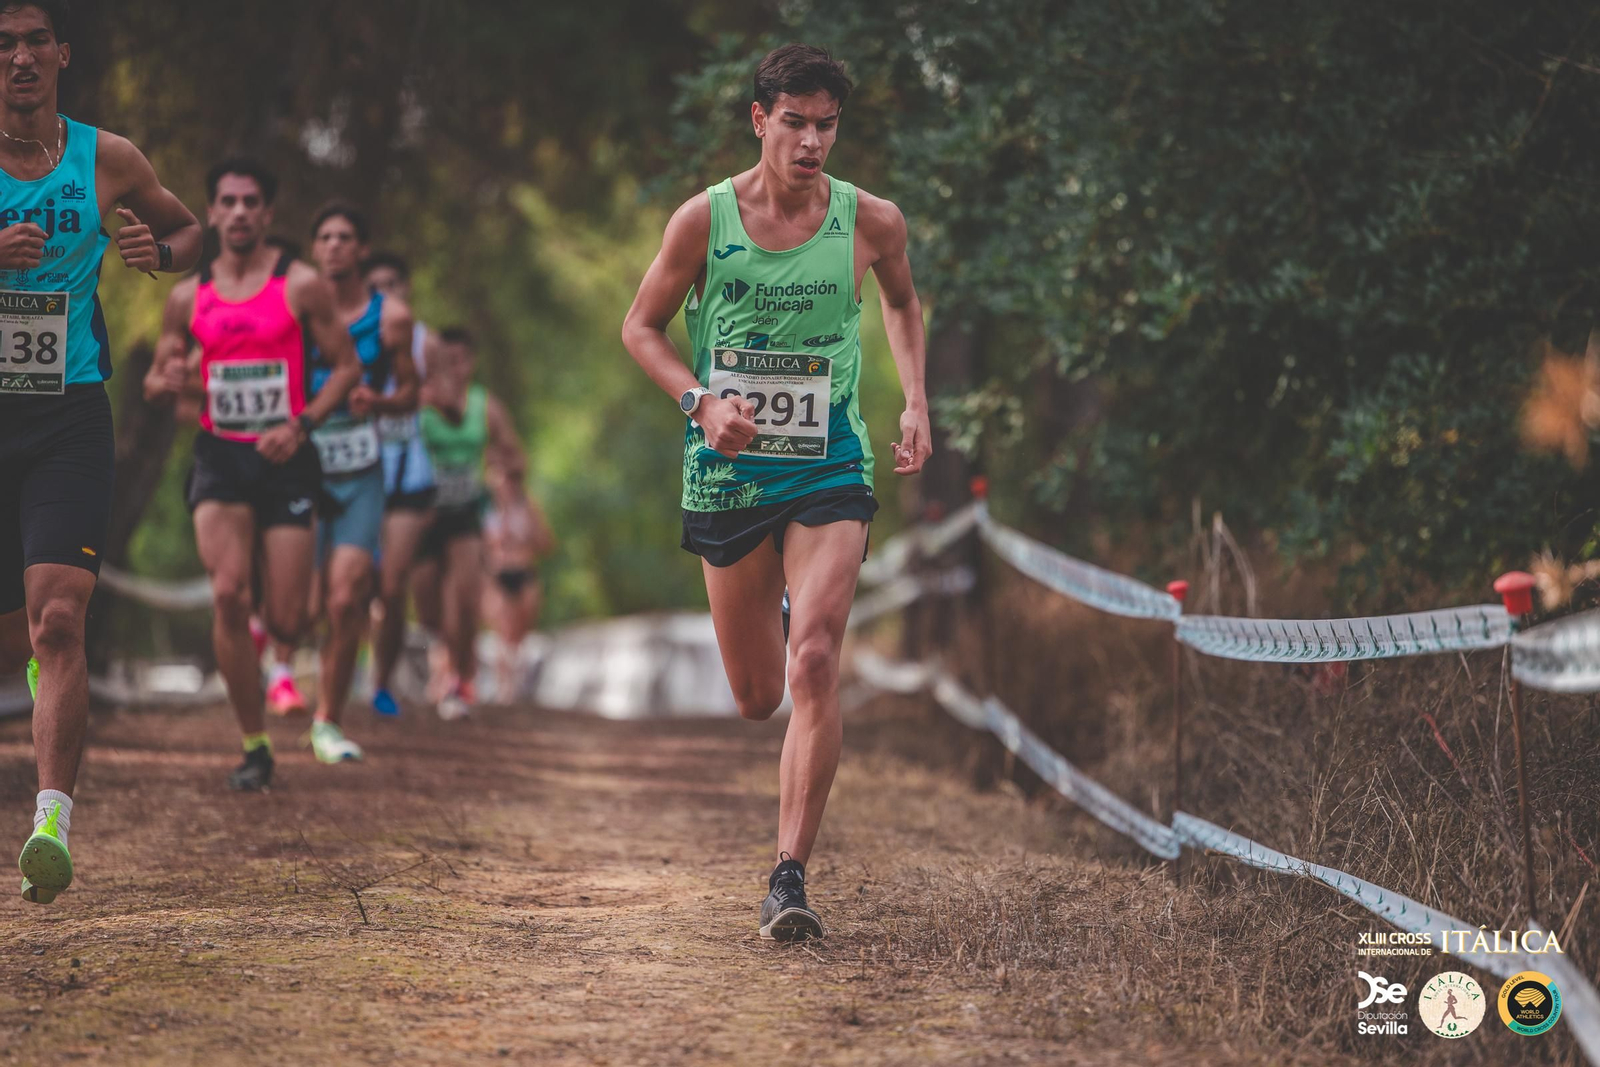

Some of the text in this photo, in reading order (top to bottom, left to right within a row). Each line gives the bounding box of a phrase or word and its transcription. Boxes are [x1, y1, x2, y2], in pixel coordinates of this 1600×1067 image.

[755, 280, 837, 297] Fundación
[754, 297, 814, 314] Unicaja
[752, 316, 778, 325] Jaén
[745, 354, 800, 369] ITÁLICA
